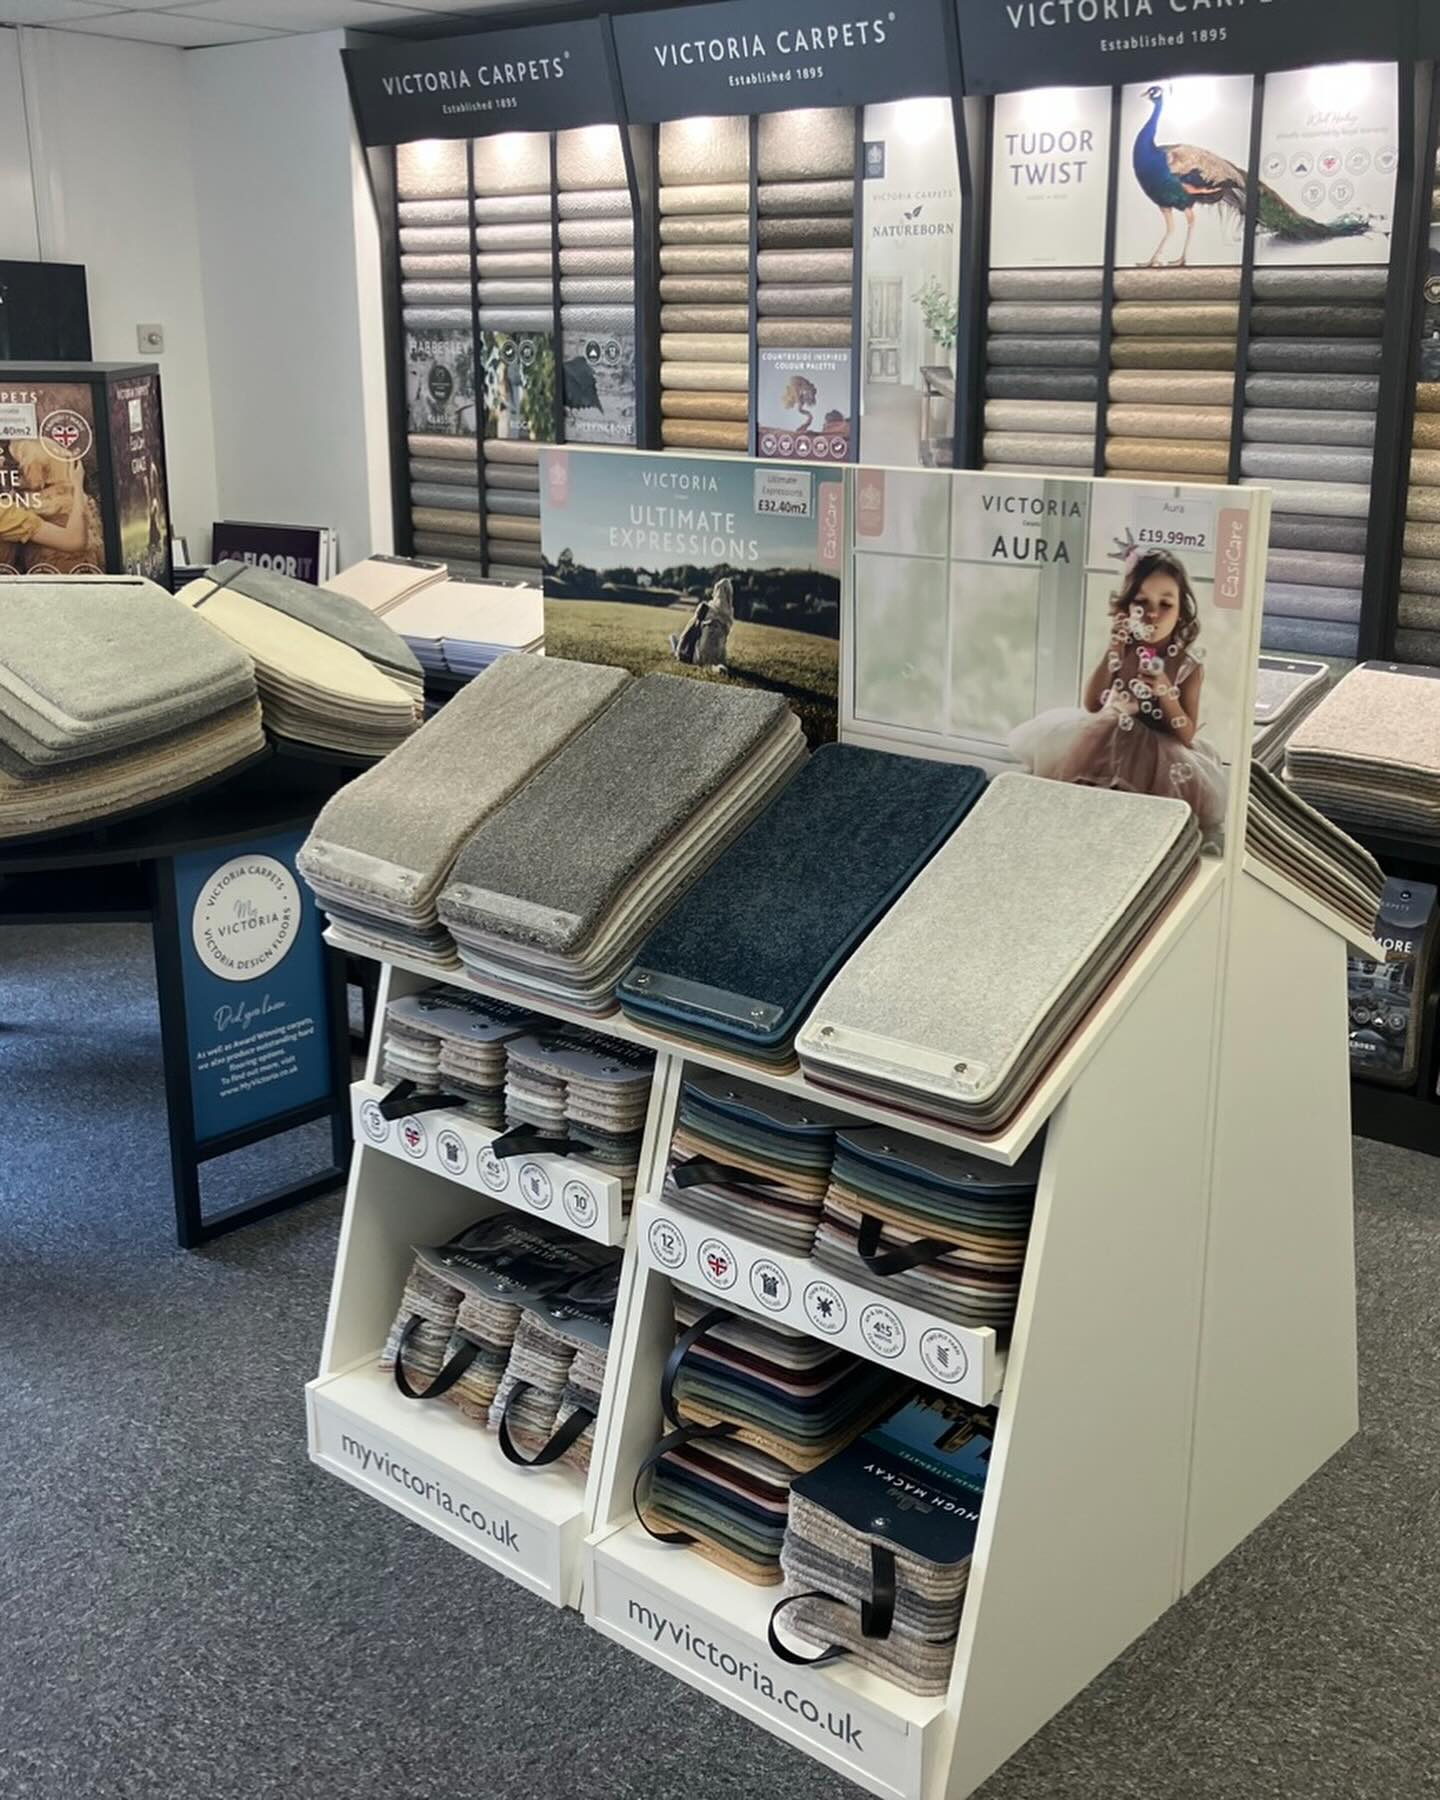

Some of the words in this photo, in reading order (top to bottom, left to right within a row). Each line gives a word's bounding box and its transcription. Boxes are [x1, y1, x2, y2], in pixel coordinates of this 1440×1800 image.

[1006, 0, 1153, 29] VICTORIA
[654, 34, 766, 67] VICTORIA
[776, 19, 886, 54] CARPETS
[1100, 31, 1184, 52] Established
[1191, 27, 1227, 43] 1895
[381, 68, 471, 96] VICTORIA
[478, 57, 565, 86] CARPETS
[728, 69, 792, 87] Established
[797, 66, 824, 80] 1895
[442, 100, 493, 114] Established
[1005, 130, 1094, 155] TUDOR
[1010, 161, 1087, 186] TWIST
[872, 223, 954, 239] NATUREBORN
[642, 471, 719, 492] VICTORIA
[630, 503, 736, 534] ULTIMATE
[758, 499, 808, 514] £32.40m2
[982, 495, 1082, 518] VICTORIA
[1162, 502, 1185, 514] Aura
[609, 526, 760, 561] EXPRESSIONS
[991, 535, 1070, 564] AURA
[1138, 528, 1206, 548] £19.99m2
[1221, 520, 1243, 600] EasiCare
[206, 867, 246, 907] VICTORIA
[248, 865, 285, 891] CARPETS
[218, 912, 279, 937] VICTORIA
[204, 928, 234, 968] VICTORIA
[237, 948, 273, 970] DESIGN
[272, 907, 291, 950] FLOORS
[573, 1194, 587, 1210] 10
[661, 1233, 674, 1249] 12
[863, 1463, 928, 1498] MACKAY
[341, 1434, 520, 1553] myvictoria.co.uk
[931, 1496, 979, 1522] HUGH
[628, 1600, 864, 1752] myvictoria.co.uk
